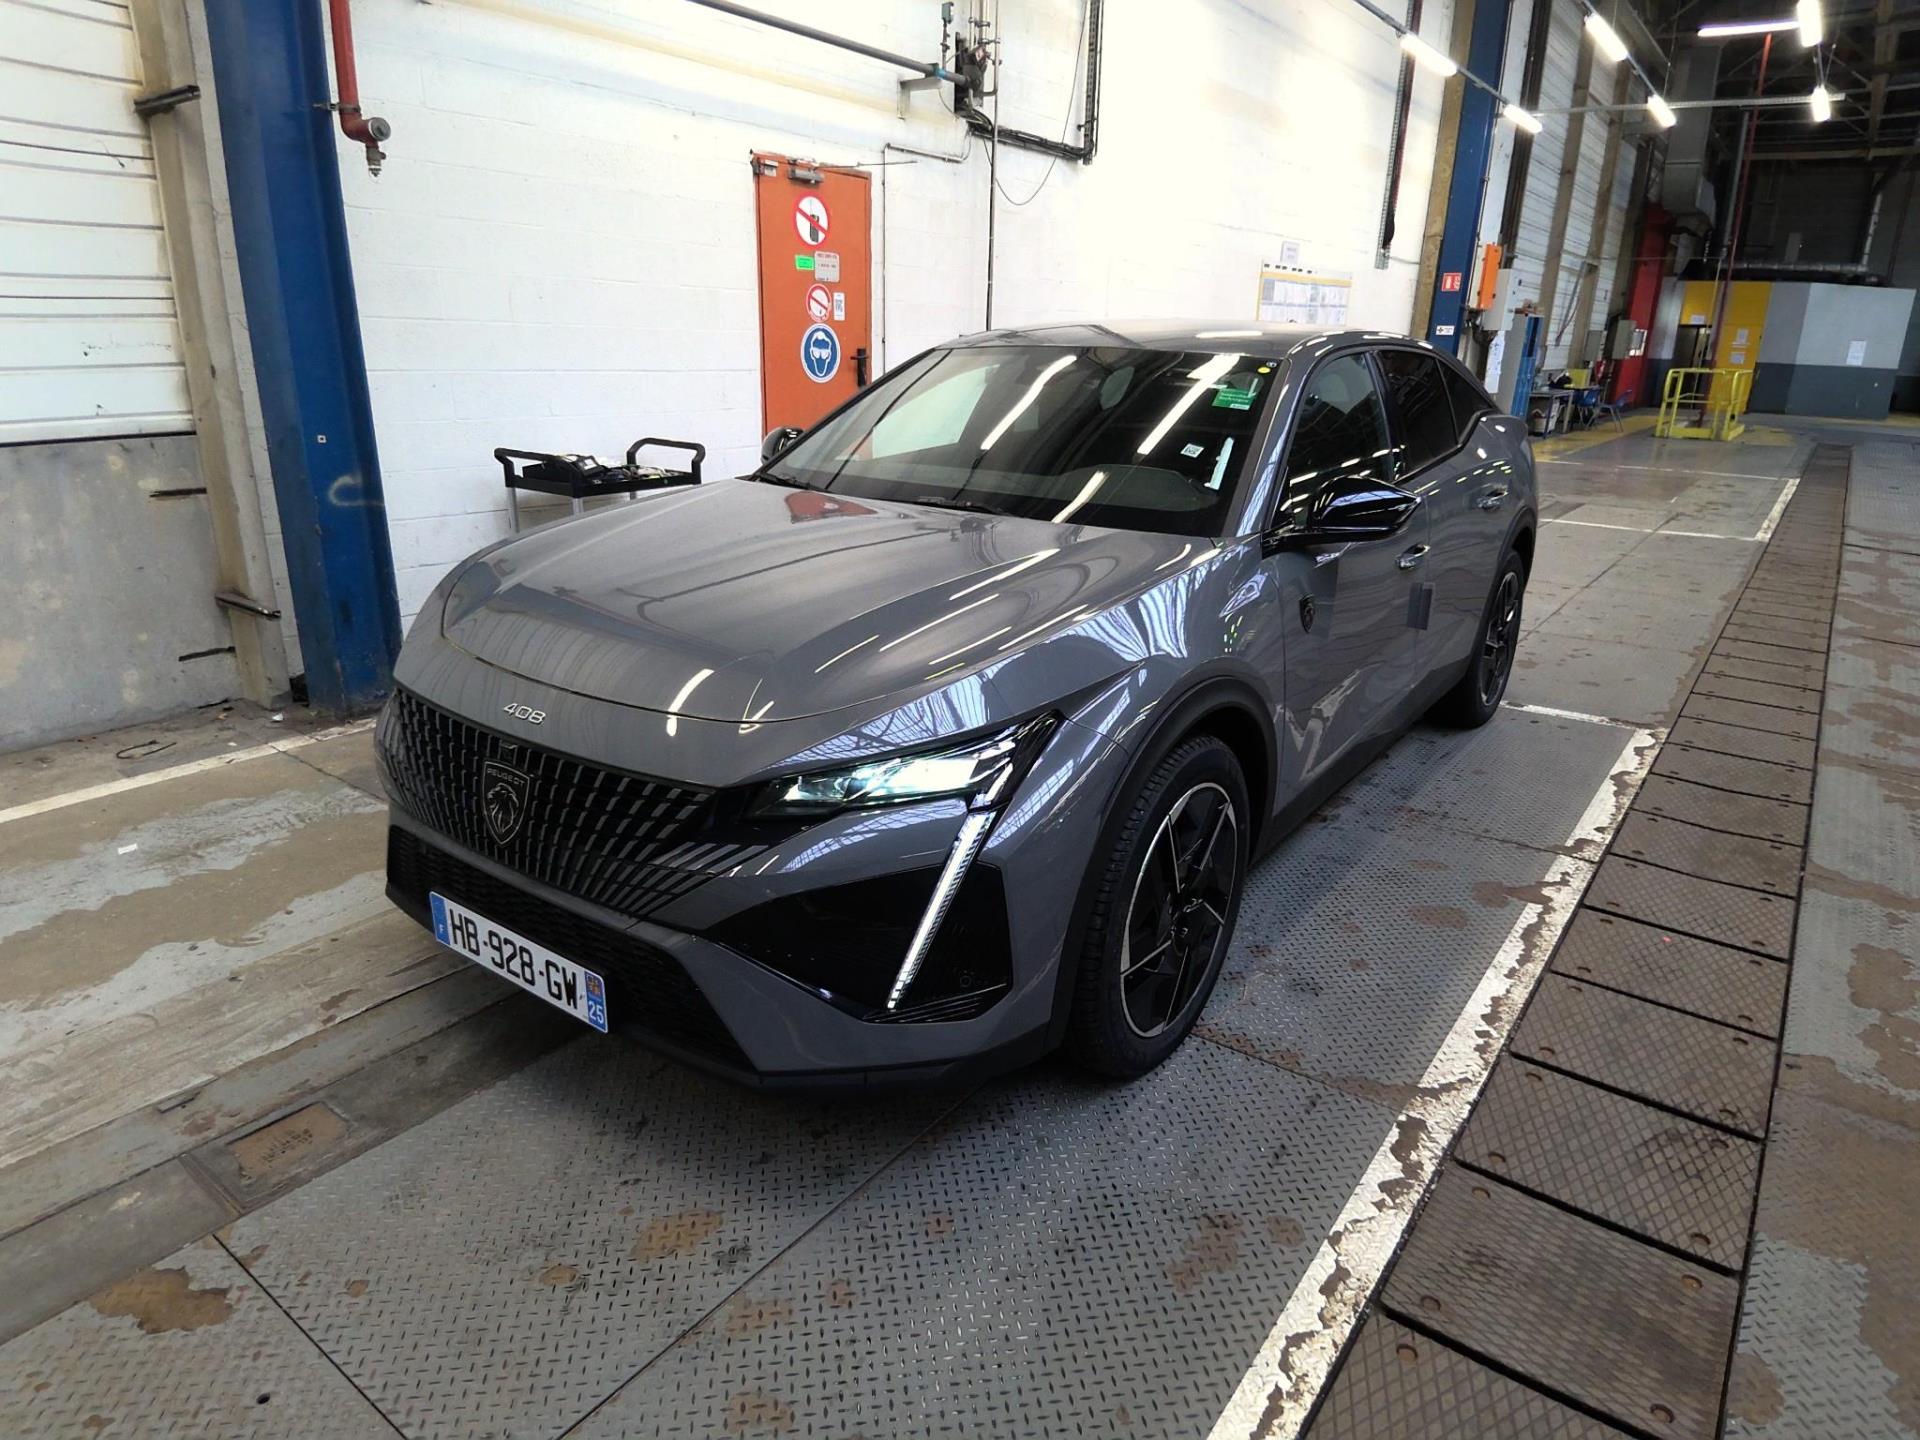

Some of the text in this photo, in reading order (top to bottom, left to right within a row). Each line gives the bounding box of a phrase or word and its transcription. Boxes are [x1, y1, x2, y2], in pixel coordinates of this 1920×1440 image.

[503, 702, 546, 724] 408
[487, 767, 525, 787] PEUGEOT
[449, 908, 578, 1010] HB-928-GW
[588, 1000, 604, 1024] 25
